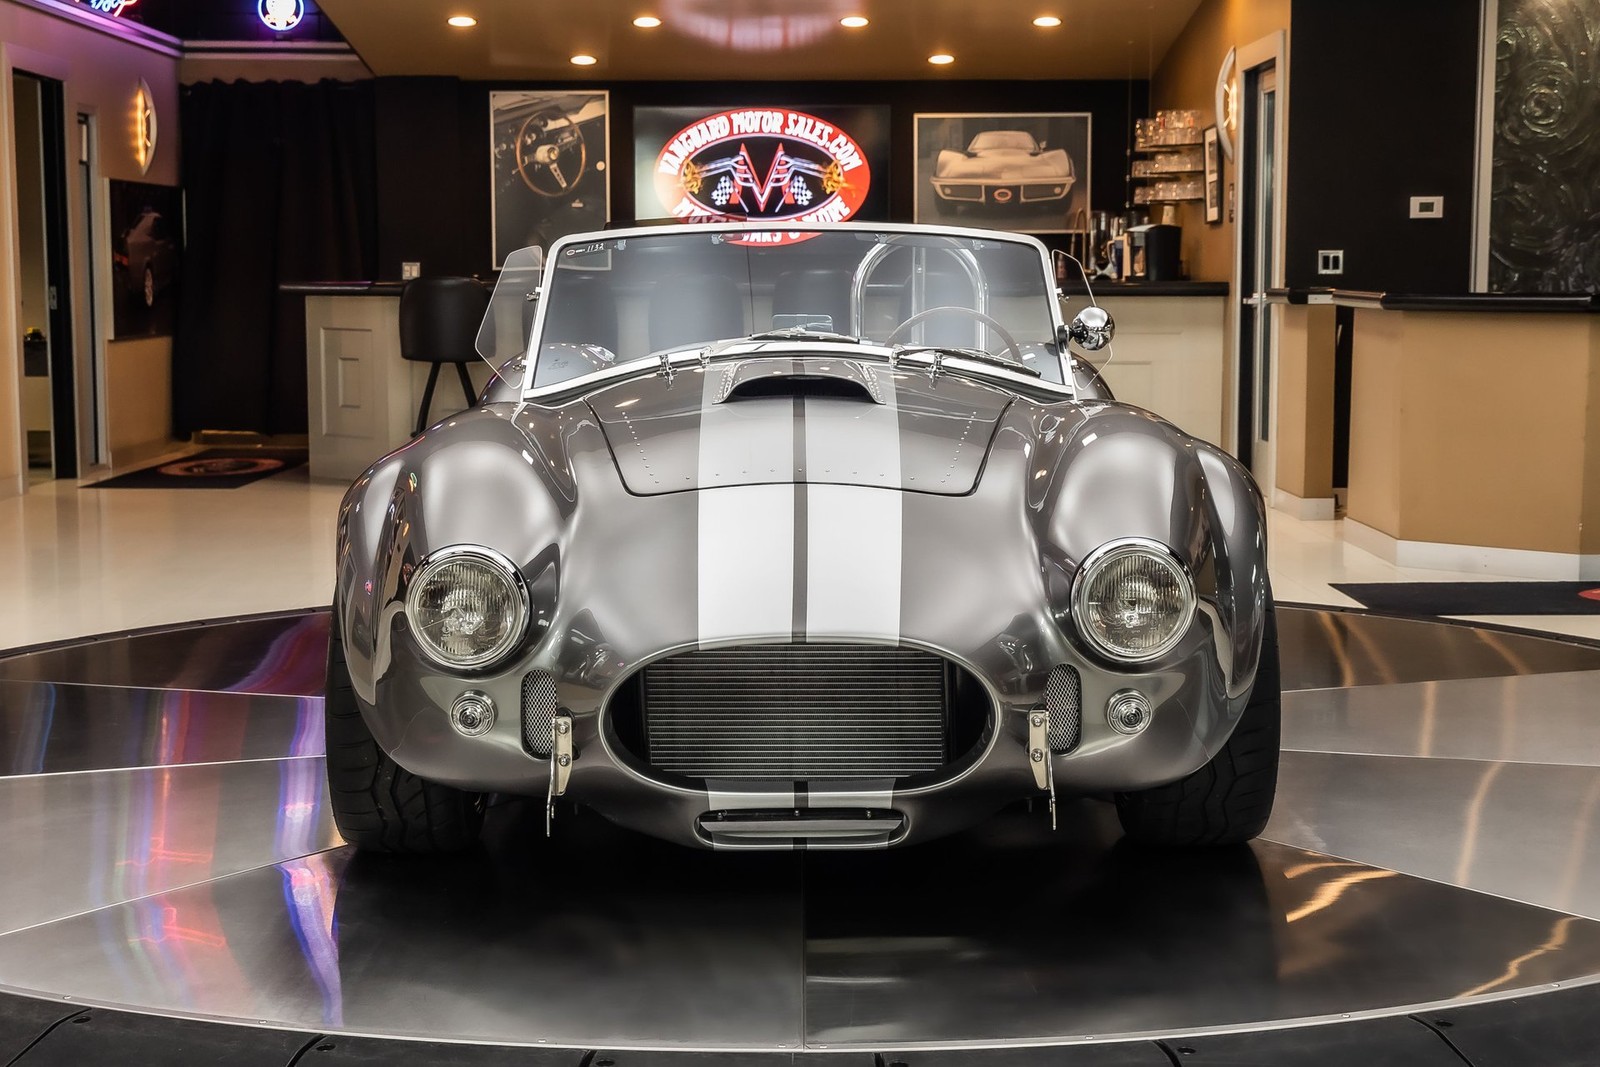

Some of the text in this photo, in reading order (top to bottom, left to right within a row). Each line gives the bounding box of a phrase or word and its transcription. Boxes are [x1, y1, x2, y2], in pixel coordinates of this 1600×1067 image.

[658, 110, 863, 176] VANGUARD MOTOR SALES.COM
